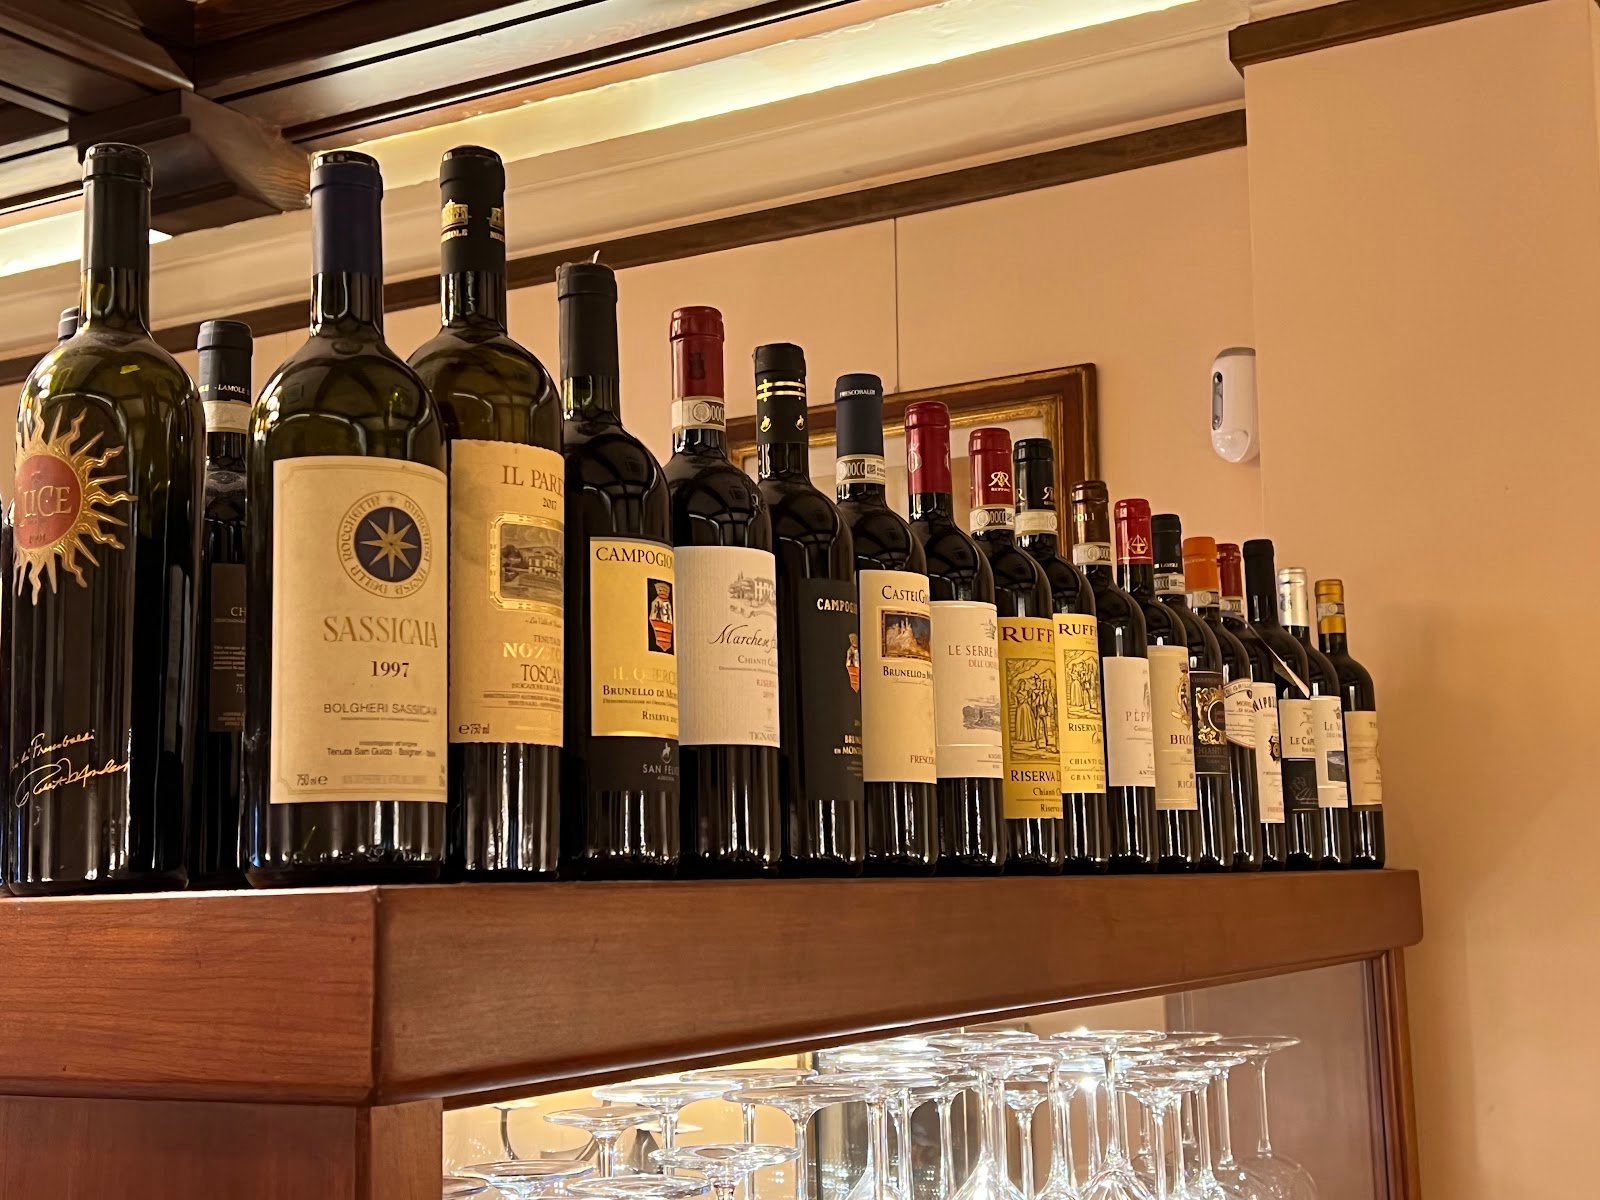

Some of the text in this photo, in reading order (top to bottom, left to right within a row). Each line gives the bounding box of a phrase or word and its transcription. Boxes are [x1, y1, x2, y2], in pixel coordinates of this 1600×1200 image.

[502, 465, 524, 486] IL
[323, 615, 439, 649] SASSICAIA
[948, 644, 961, 656] LE
[966, 645, 992, 658] SERRE
[370, 660, 410, 678] 1997
[884, 665, 922, 679] BRUNELLO
[603, 684, 654, 697] BRUNELLO
[323, 702, 389, 714] BOLGHERI
[327, 747, 353, 756] Tenuta
[643, 764, 661, 774] SAN
[1011, 769, 1055, 782] RISERVA
